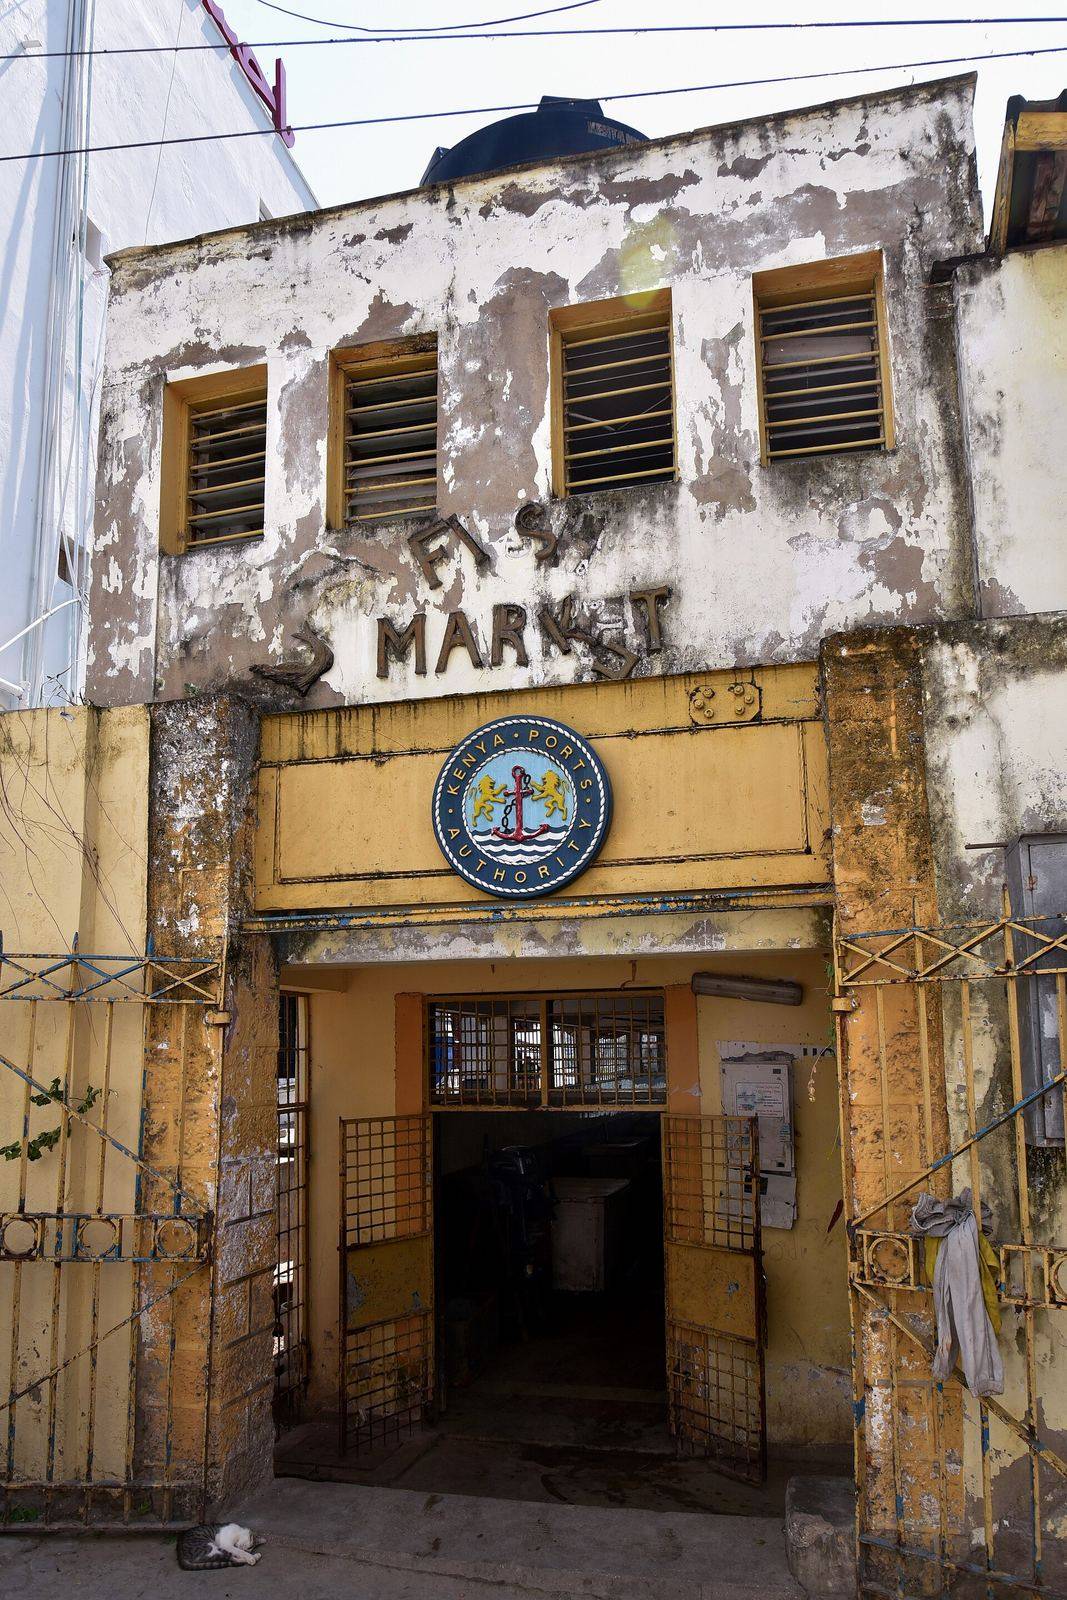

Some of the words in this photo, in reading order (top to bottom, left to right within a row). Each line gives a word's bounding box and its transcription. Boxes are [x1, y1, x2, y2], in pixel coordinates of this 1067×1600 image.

[447, 734, 505, 796] KENYA
[528, 729, 592, 790] PORTS
[448, 818, 592, 883] AUTHORITY
